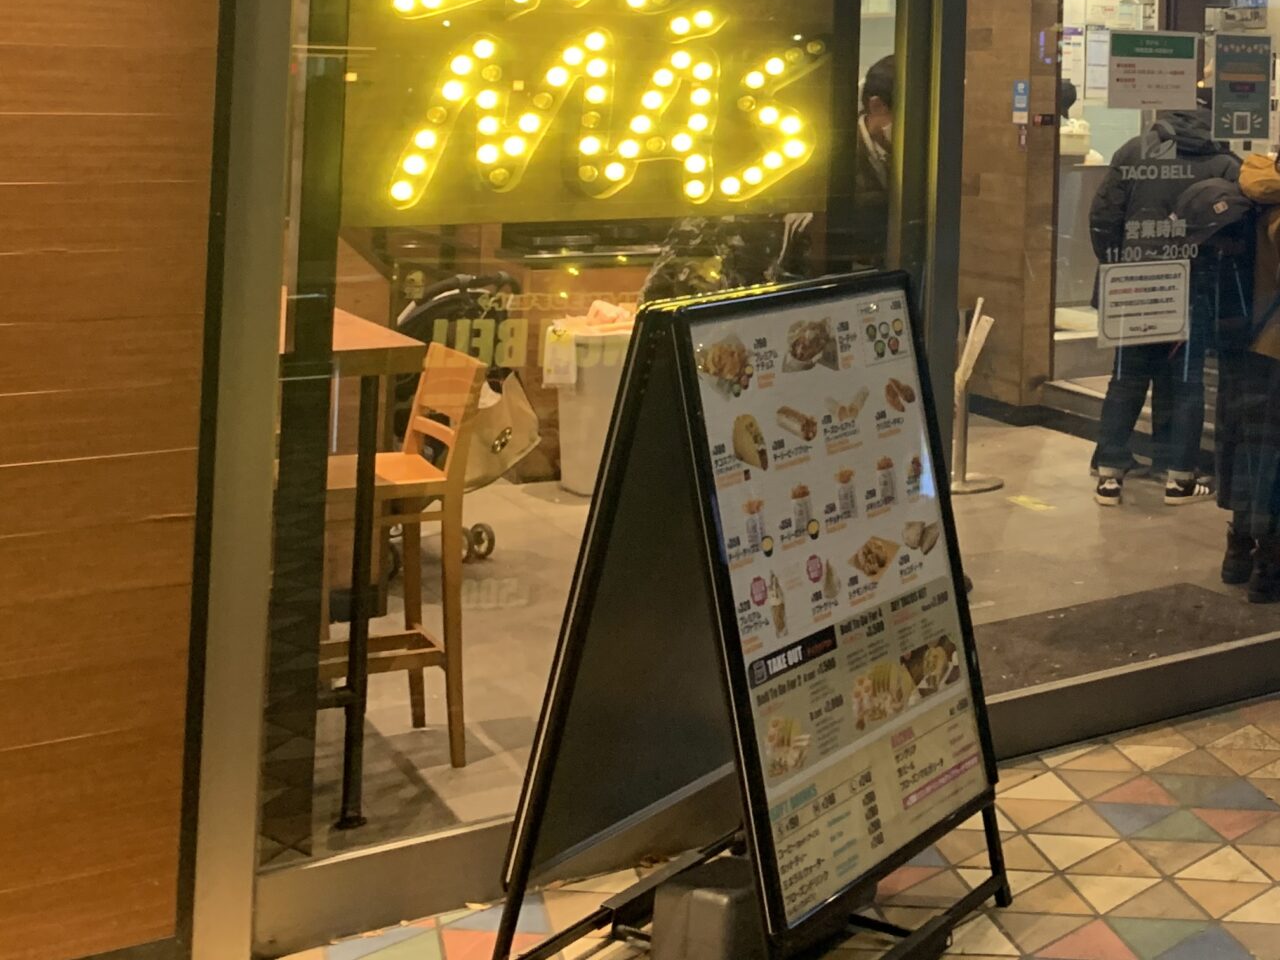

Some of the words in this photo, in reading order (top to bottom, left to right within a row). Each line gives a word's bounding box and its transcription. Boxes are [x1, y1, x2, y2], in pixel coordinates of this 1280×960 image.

[1120, 165, 1158, 179] TACO
[1161, 164, 1194, 179] BELL
[1125, 219, 1186, 239] 営業時間
[1106, 246, 1141, 262] 11:00
[1162, 243, 1199, 258] 20:00
[766, 653, 788, 675] TAKE
[786, 645, 803, 666] OUT
